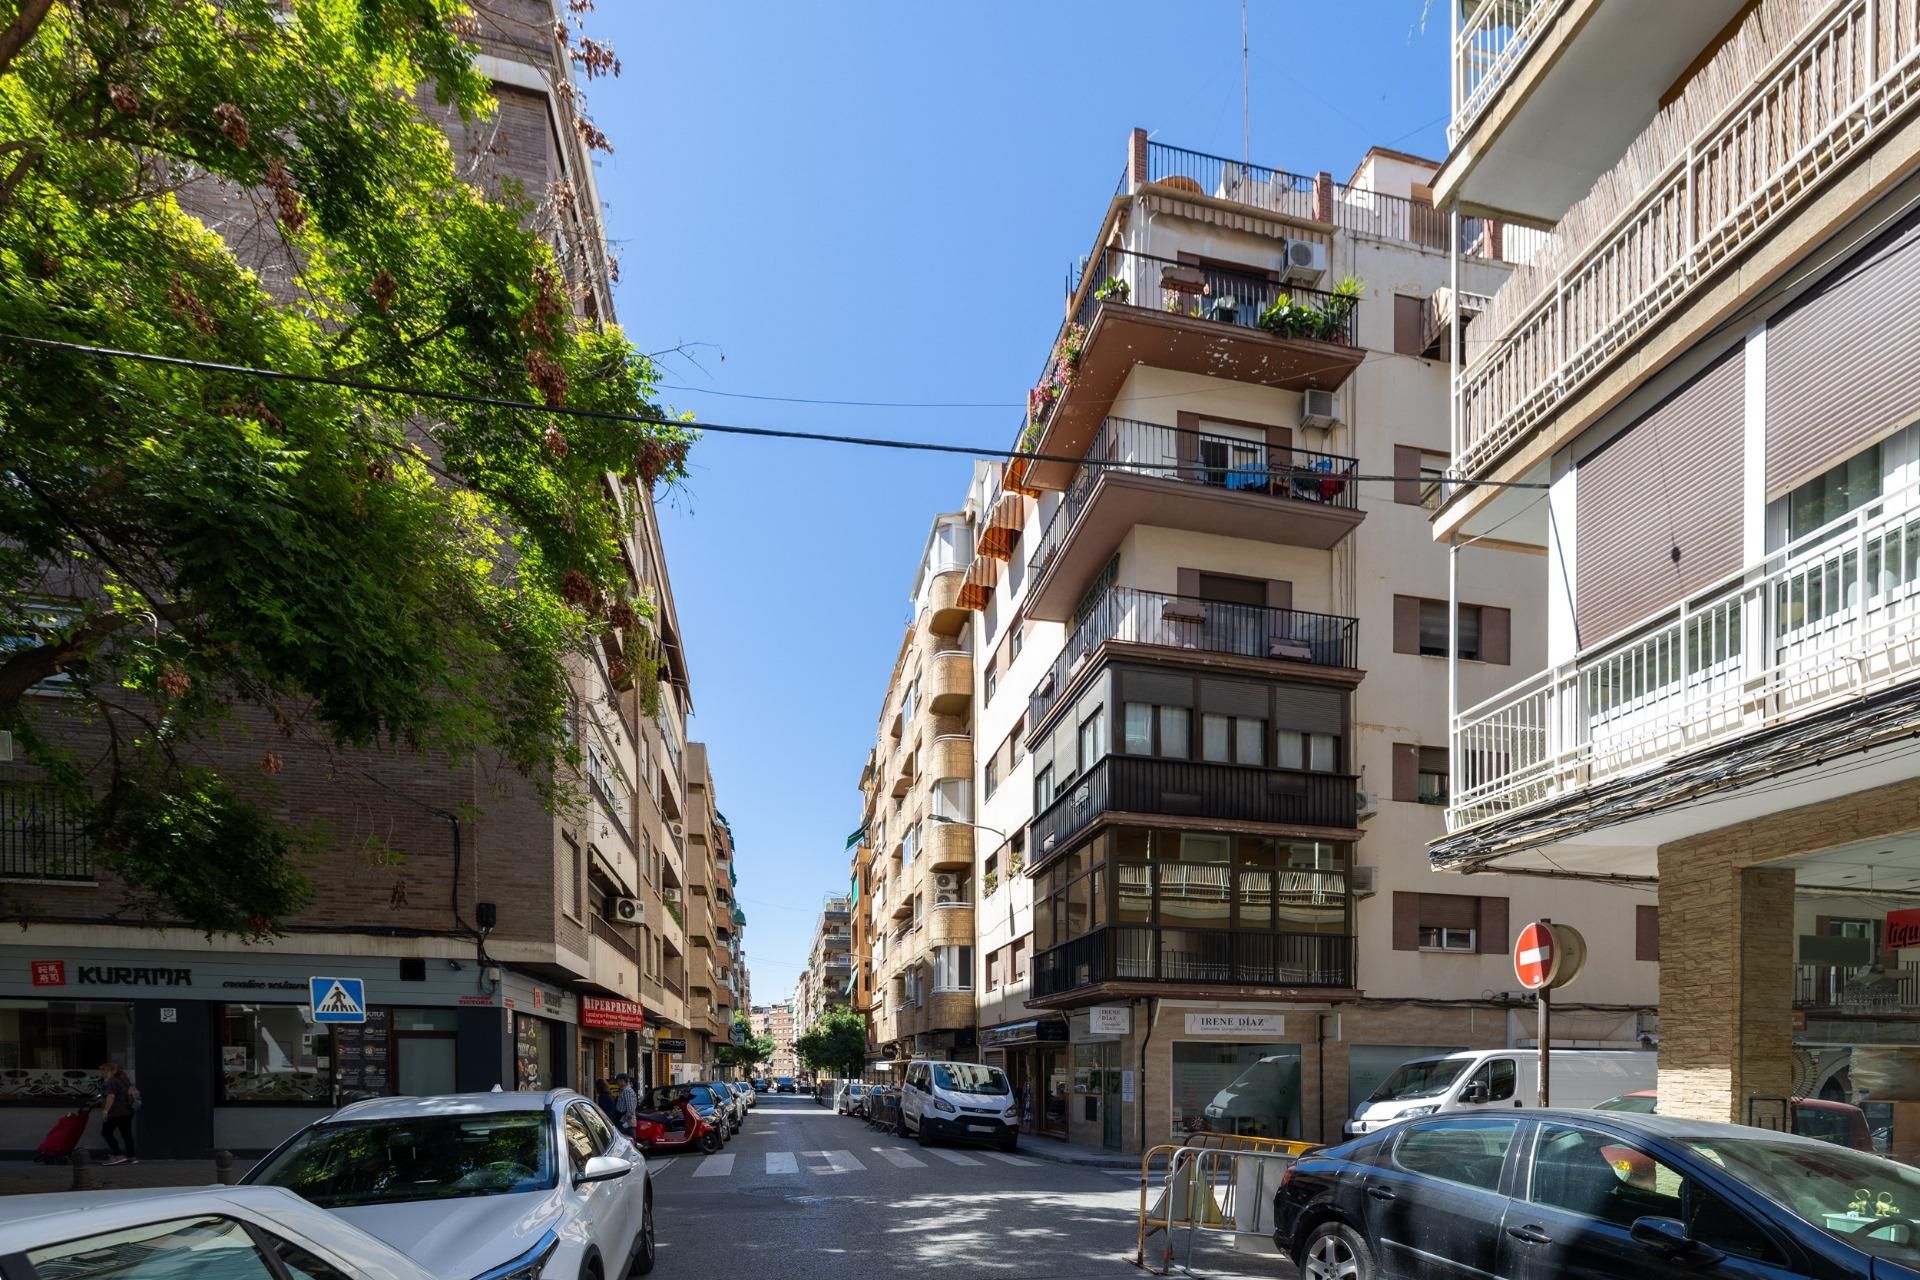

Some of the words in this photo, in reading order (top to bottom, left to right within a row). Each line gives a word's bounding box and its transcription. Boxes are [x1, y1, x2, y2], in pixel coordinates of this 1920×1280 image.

[78, 966, 192, 986] KURAMA
[584, 998, 643, 1016] HIPERPRENSA
[1201, 1017, 1234, 1026] IRENE
[1238, 1016, 1265, 1026] DÍAZ
